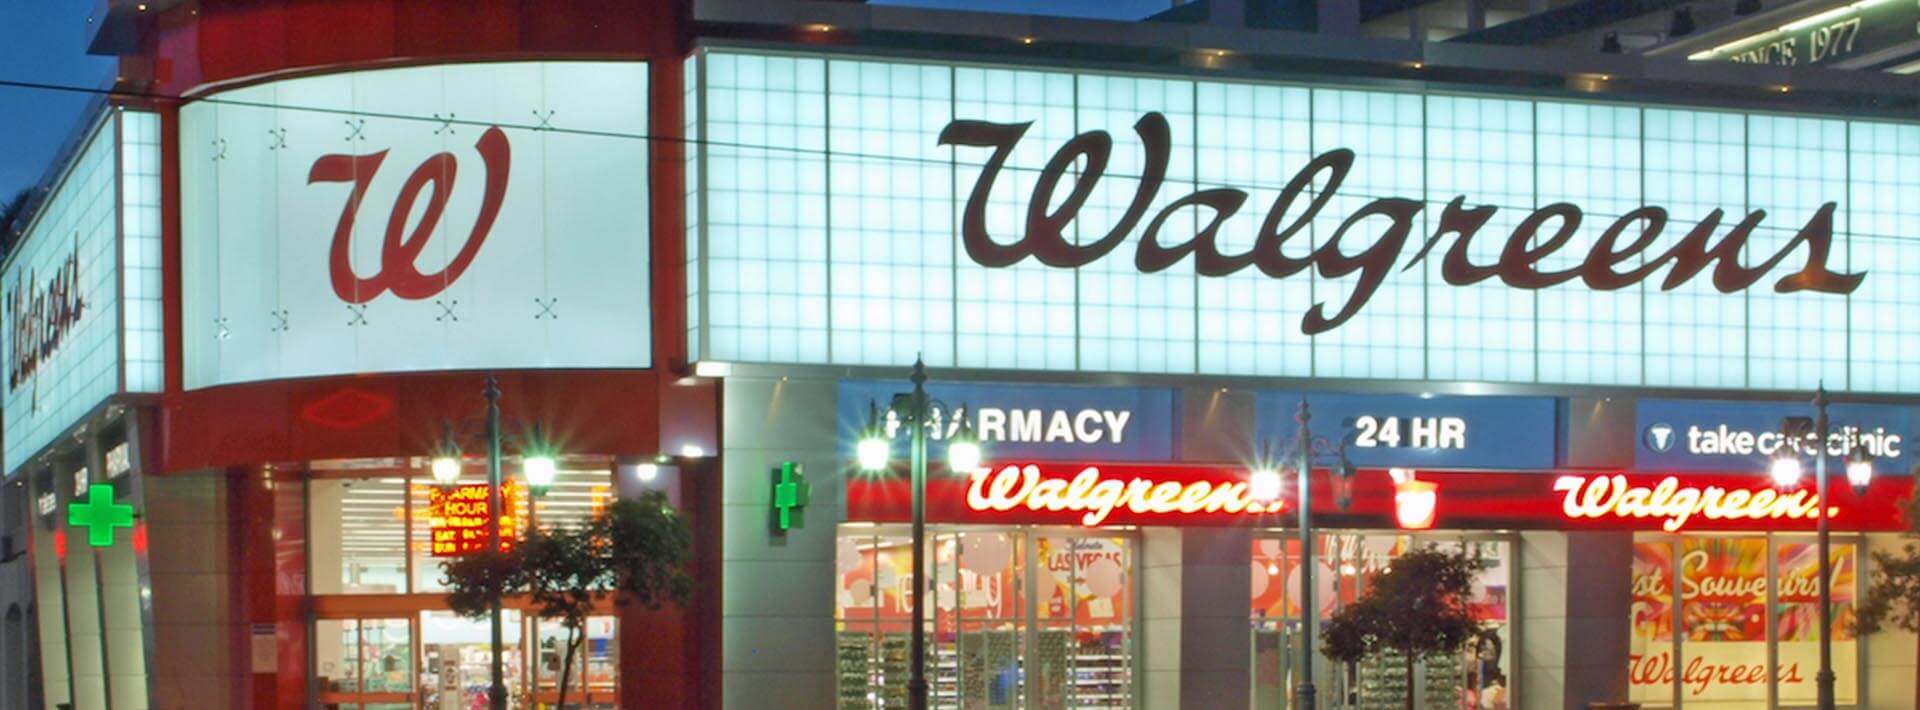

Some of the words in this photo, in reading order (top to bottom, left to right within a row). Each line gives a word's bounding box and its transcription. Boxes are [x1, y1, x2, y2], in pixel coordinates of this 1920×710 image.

[1809, 17, 1861, 62] 1977
[307, 125, 511, 304] W
[938, 111, 1870, 335] Walgreens
[1355, 415, 1401, 447] 24
[1412, 417, 1466, 449] HR
[1688, 424, 1755, 455] take
[445, 502, 488, 516] HOUR
[966, 465, 1284, 527] Walgreen
[1048, 552, 1072, 572] LAS
[1075, 551, 1122, 571] VES
[1632, 566, 1665, 597] st
